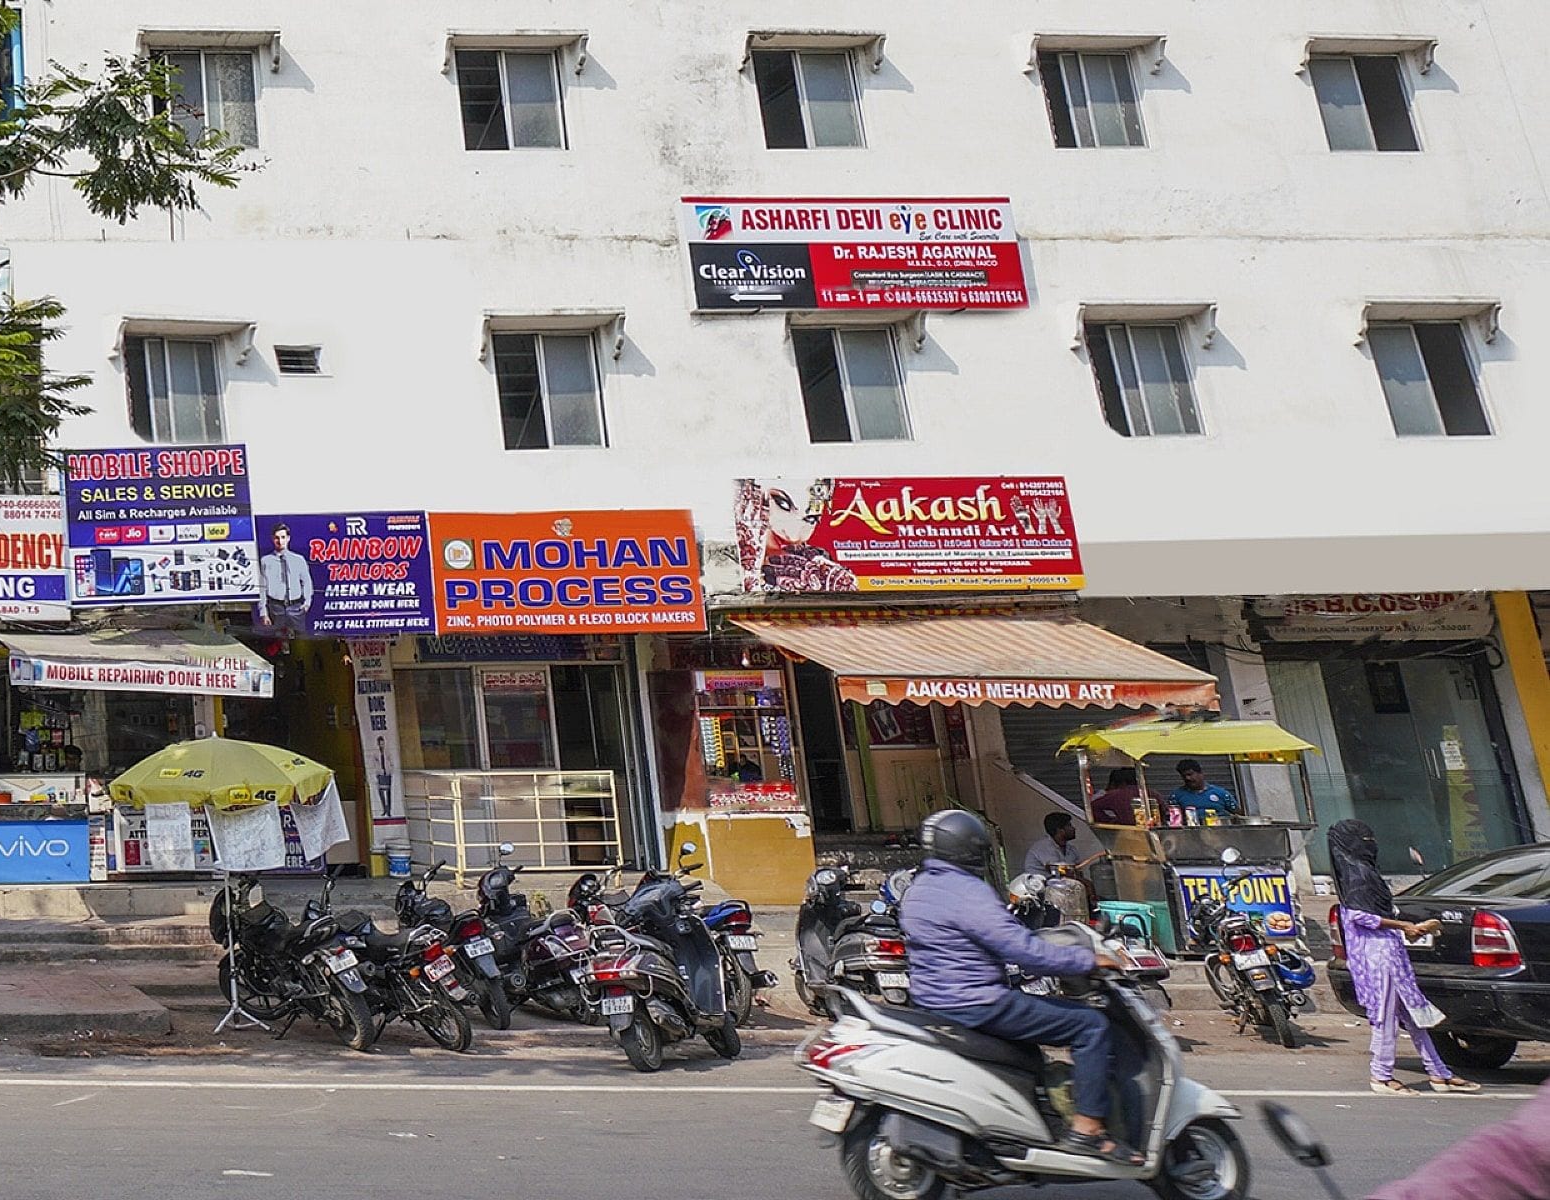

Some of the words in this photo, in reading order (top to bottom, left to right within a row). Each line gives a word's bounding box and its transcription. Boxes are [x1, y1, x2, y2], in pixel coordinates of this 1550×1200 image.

[741, 209, 830, 230] ASHARFI
[836, 209, 883, 230] DEVI
[889, 211, 927, 234] eye
[933, 208, 1002, 230] CLINIC
[833, 245, 854, 259] Dr.
[858, 245, 917, 259] RAJESH
[922, 245, 996, 259] AGARWAL
[699, 264, 746, 279] Clear
[749, 264, 806, 279] Vision
[68, 452, 152, 480] MOBILE
[158, 449, 245, 477] SHOPPE
[80, 487, 138, 503] SALES
[143, 486, 155, 501] &
[160, 483, 235, 500] SERVICE
[78, 509, 92, 521] All
[95, 509, 116, 520] Sim
[118, 508, 128, 519] &
[130, 507, 187, 520] Recharges
[189, 505, 237, 517] Available
[830, 485, 1007, 535] Aakash
[897, 524, 980, 537] Mehandi
[985, 524, 1019, 537] Art
[309, 536, 423, 562] RAINBOW
[482, 536, 690, 571] MOHAN
[328, 562, 409, 581] TAILORS
[324, 584, 369, 597] MENS
[372, 582, 416, 596] WEAR
[444, 575, 694, 610] PROCESS
[371, 599, 395, 609] DONE
[397, 598, 420, 609] HERE
[313, 620, 335, 630] PICO
[345, 619, 364, 630] FALL
[406, 617, 430, 628] HERE
[446, 614, 476, 628] ZINC,
[477, 614, 513, 627] PHOTO
[515, 614, 565, 627] POLYMER
[568, 613, 577, 625] &
[579, 612, 612, 625] FLEXO
[615, 612, 649, 625] BLOCK
[652, 611, 696, 624] MAKERS
[47, 664, 94, 682] MOBILE
[98, 668, 164, 685] REPAIRING
[168, 671, 202, 687] DONE
[206, 673, 237, 689] HERE
[905, 681, 982, 699] AAKASH
[986, 683, 1072, 699] MEHANDI
[1078, 683, 1116, 701] ART
[254, 789, 276, 801] 4G
[1228, 877, 1286, 904] POINT
